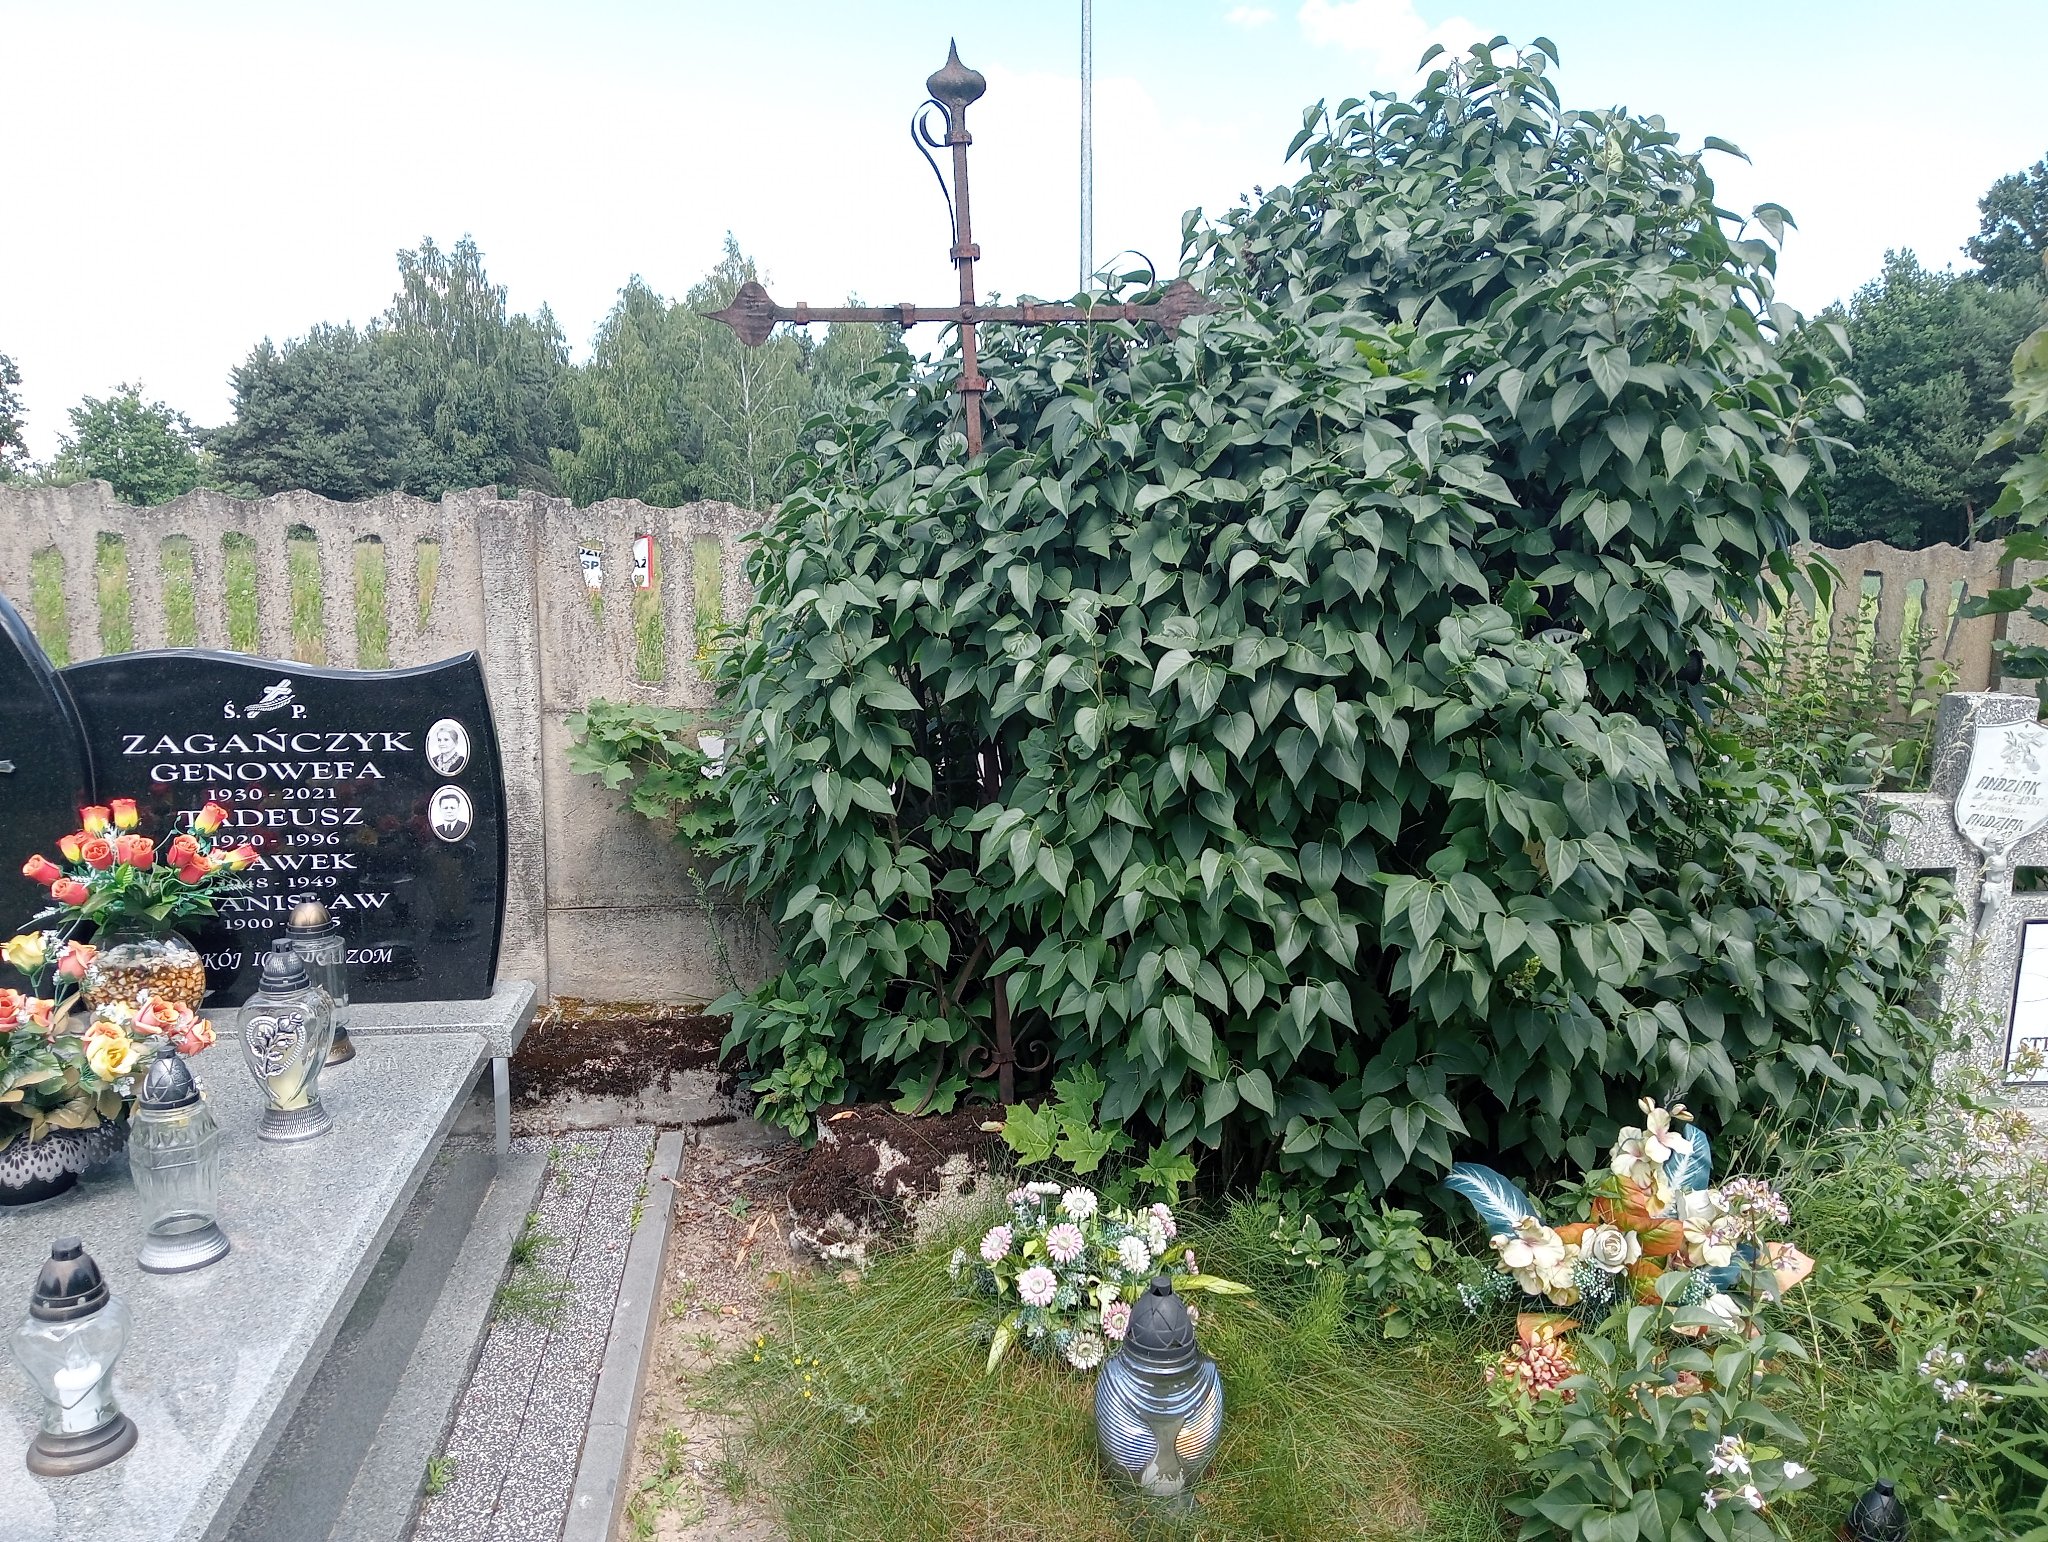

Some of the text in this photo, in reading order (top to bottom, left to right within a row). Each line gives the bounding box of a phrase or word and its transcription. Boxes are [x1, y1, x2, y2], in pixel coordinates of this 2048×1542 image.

[224, 701, 307, 719] Ś. P.
[122, 728, 413, 755] ZAGAŃCZYK
[150, 761, 386, 782] GENOWEFA
[208, 788, 262, 801] 1930
[282, 787, 337, 800] 2021
[177, 807, 364, 828] TDEUSZ
[211, 834, 265, 847] 1920
[286, 832, 340, 846] 1996
[289, 876, 337, 888] 1949
[224, 918, 274, 930] 1900
